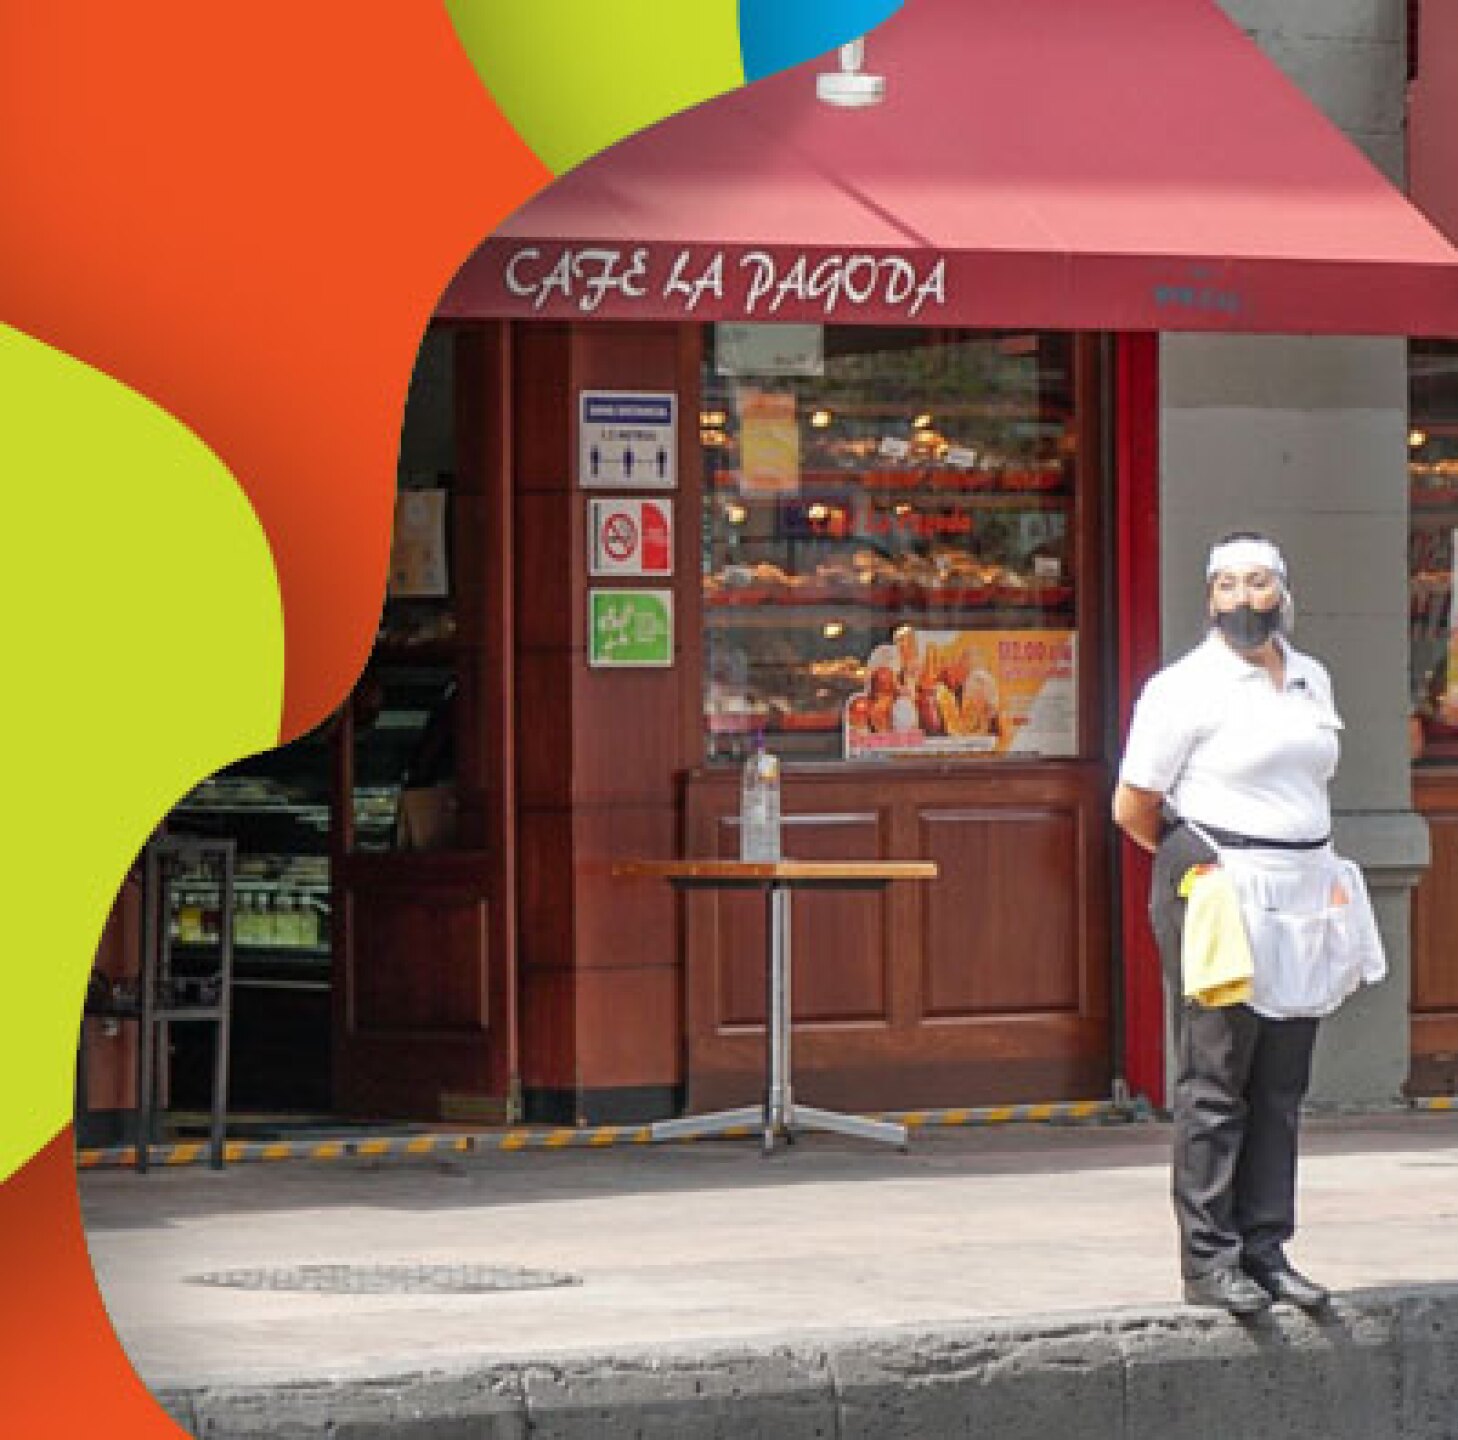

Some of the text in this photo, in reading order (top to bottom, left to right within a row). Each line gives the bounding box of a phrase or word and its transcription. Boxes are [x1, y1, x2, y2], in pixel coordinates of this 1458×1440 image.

[505, 247, 946, 315] CAFE LA PAGODA
